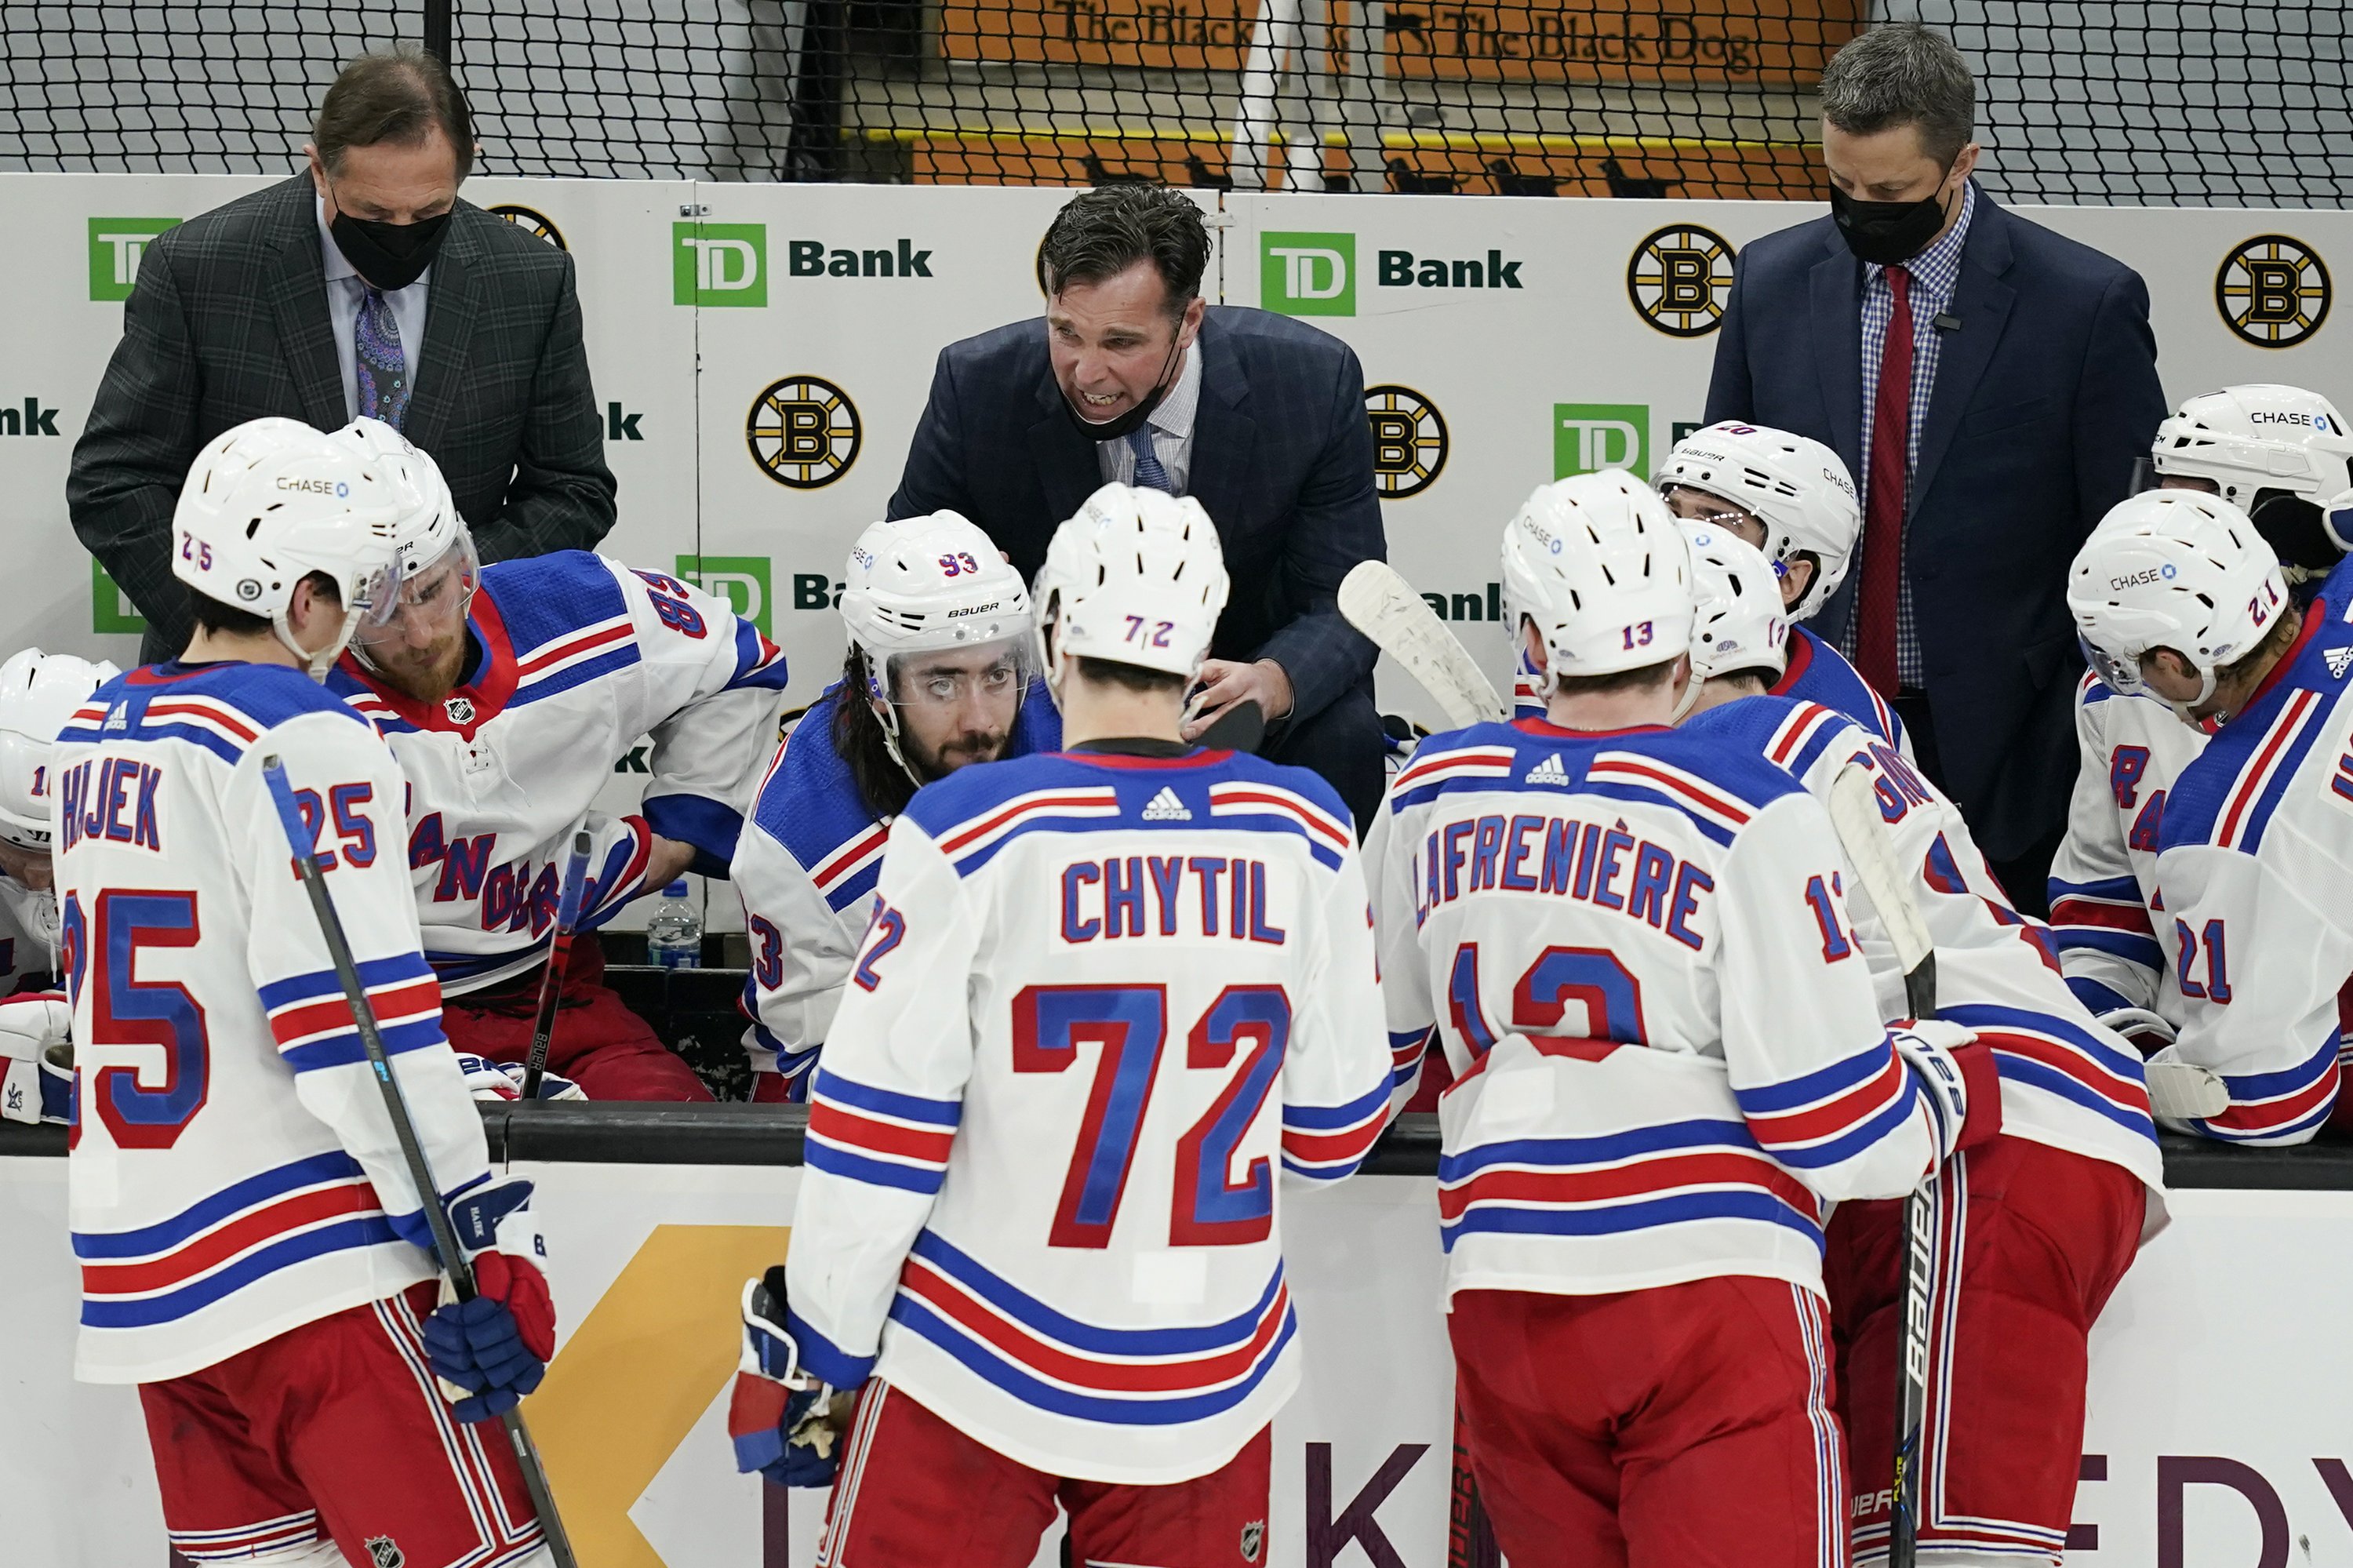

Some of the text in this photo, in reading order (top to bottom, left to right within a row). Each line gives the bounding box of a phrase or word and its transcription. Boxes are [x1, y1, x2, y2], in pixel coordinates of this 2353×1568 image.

[1053, 0, 1256, 48] The Black
[1442, 11, 1751, 75] The Black Dog
[682, 238, 933, 290] TD Bank
[1270, 248, 1524, 299] TD Bank
[2251, 413, 2311, 426] CHASE
[1563, 420, 1640, 471] TD
[276, 477, 333, 495] CHASE
[1823, 467, 1856, 500] CHASE
[182, 530, 213, 571] 25
[1523, 515, 1551, 548] CHASE
[938, 552, 979, 577] 93
[2110, 569, 2161, 591] CHASE
[2248, 578, 2279, 628] 21
[1125, 614, 1174, 648] 72
[1622, 621, 1654, 650] 13
[2333, 643, 2353, 679] adida
[31, 766, 50, 798] 1
[291, 781, 376, 881] 25
[1061, 856, 1286, 945] CHYTIL
[1413, 814, 1715, 951] LAFRENIÈRE
[1805, 871, 1864, 964] 1
[749, 912, 783, 992] 3
[2176, 916, 2232, 1006] 21
[1011, 982, 1293, 1250] 72
